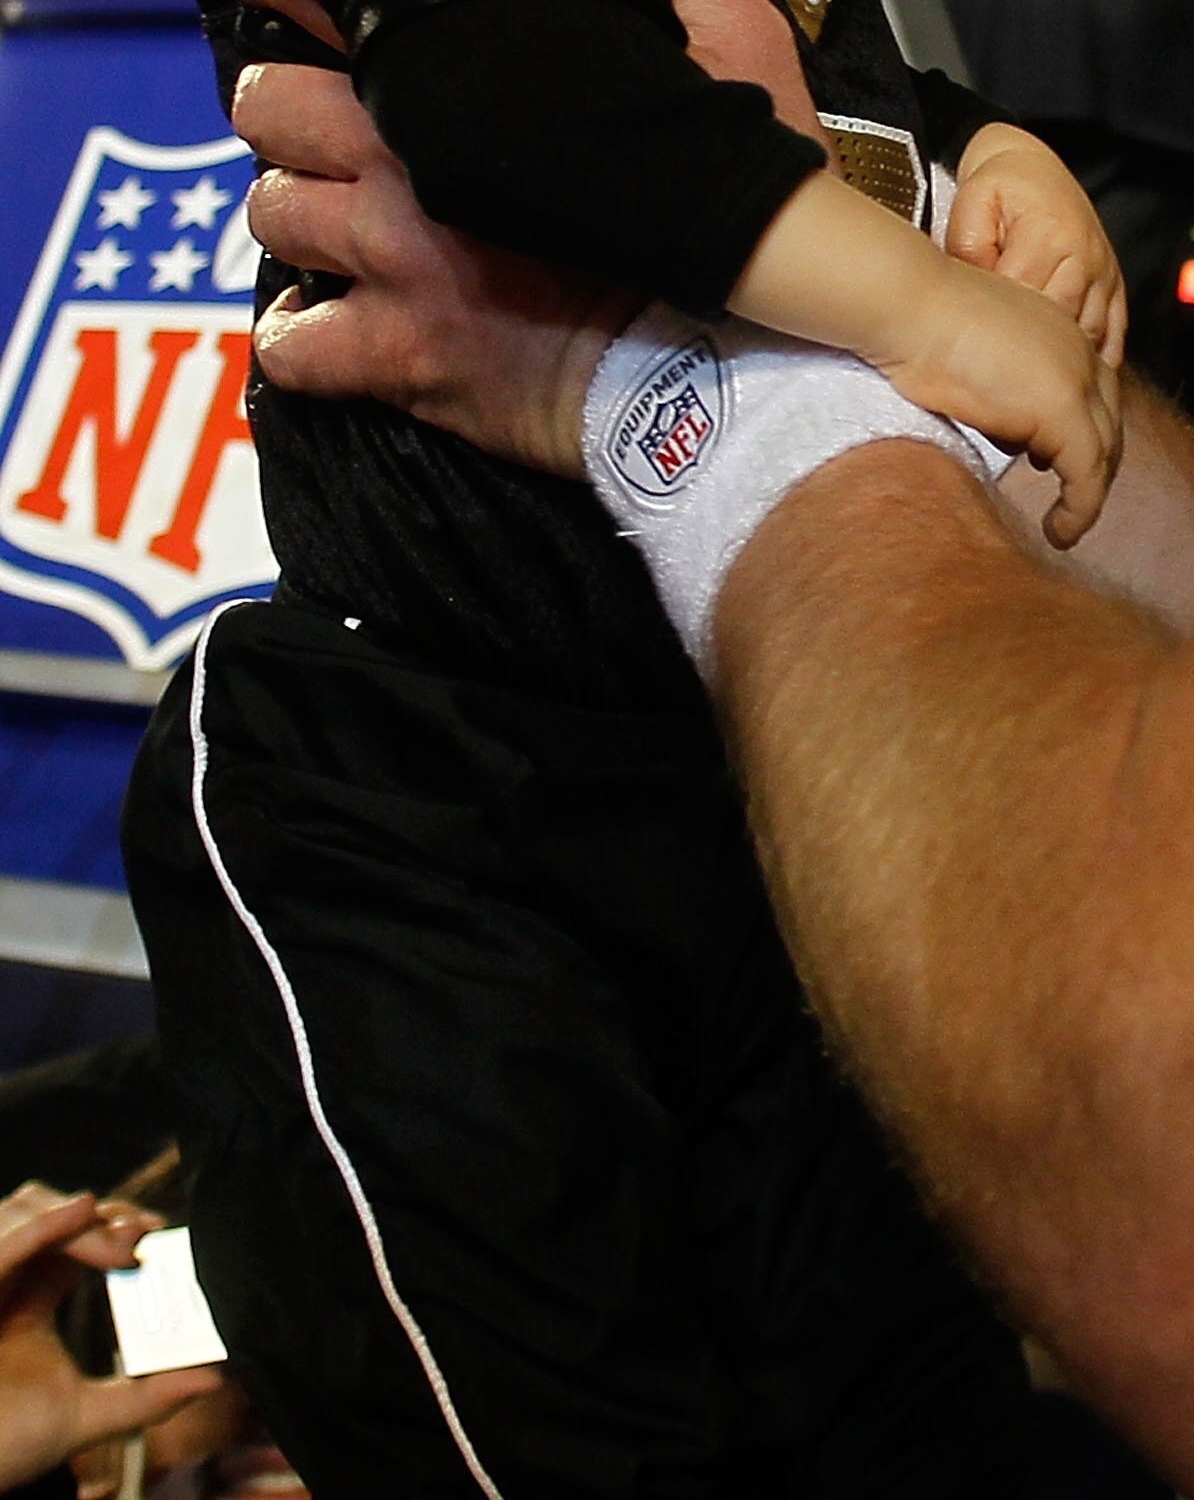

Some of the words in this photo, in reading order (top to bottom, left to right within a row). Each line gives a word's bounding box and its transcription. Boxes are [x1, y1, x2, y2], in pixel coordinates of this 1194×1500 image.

[16, 329, 256, 575] NF
[613, 349, 708, 461] EQUIPMENT
[655, 414, 711, 478] NFL
